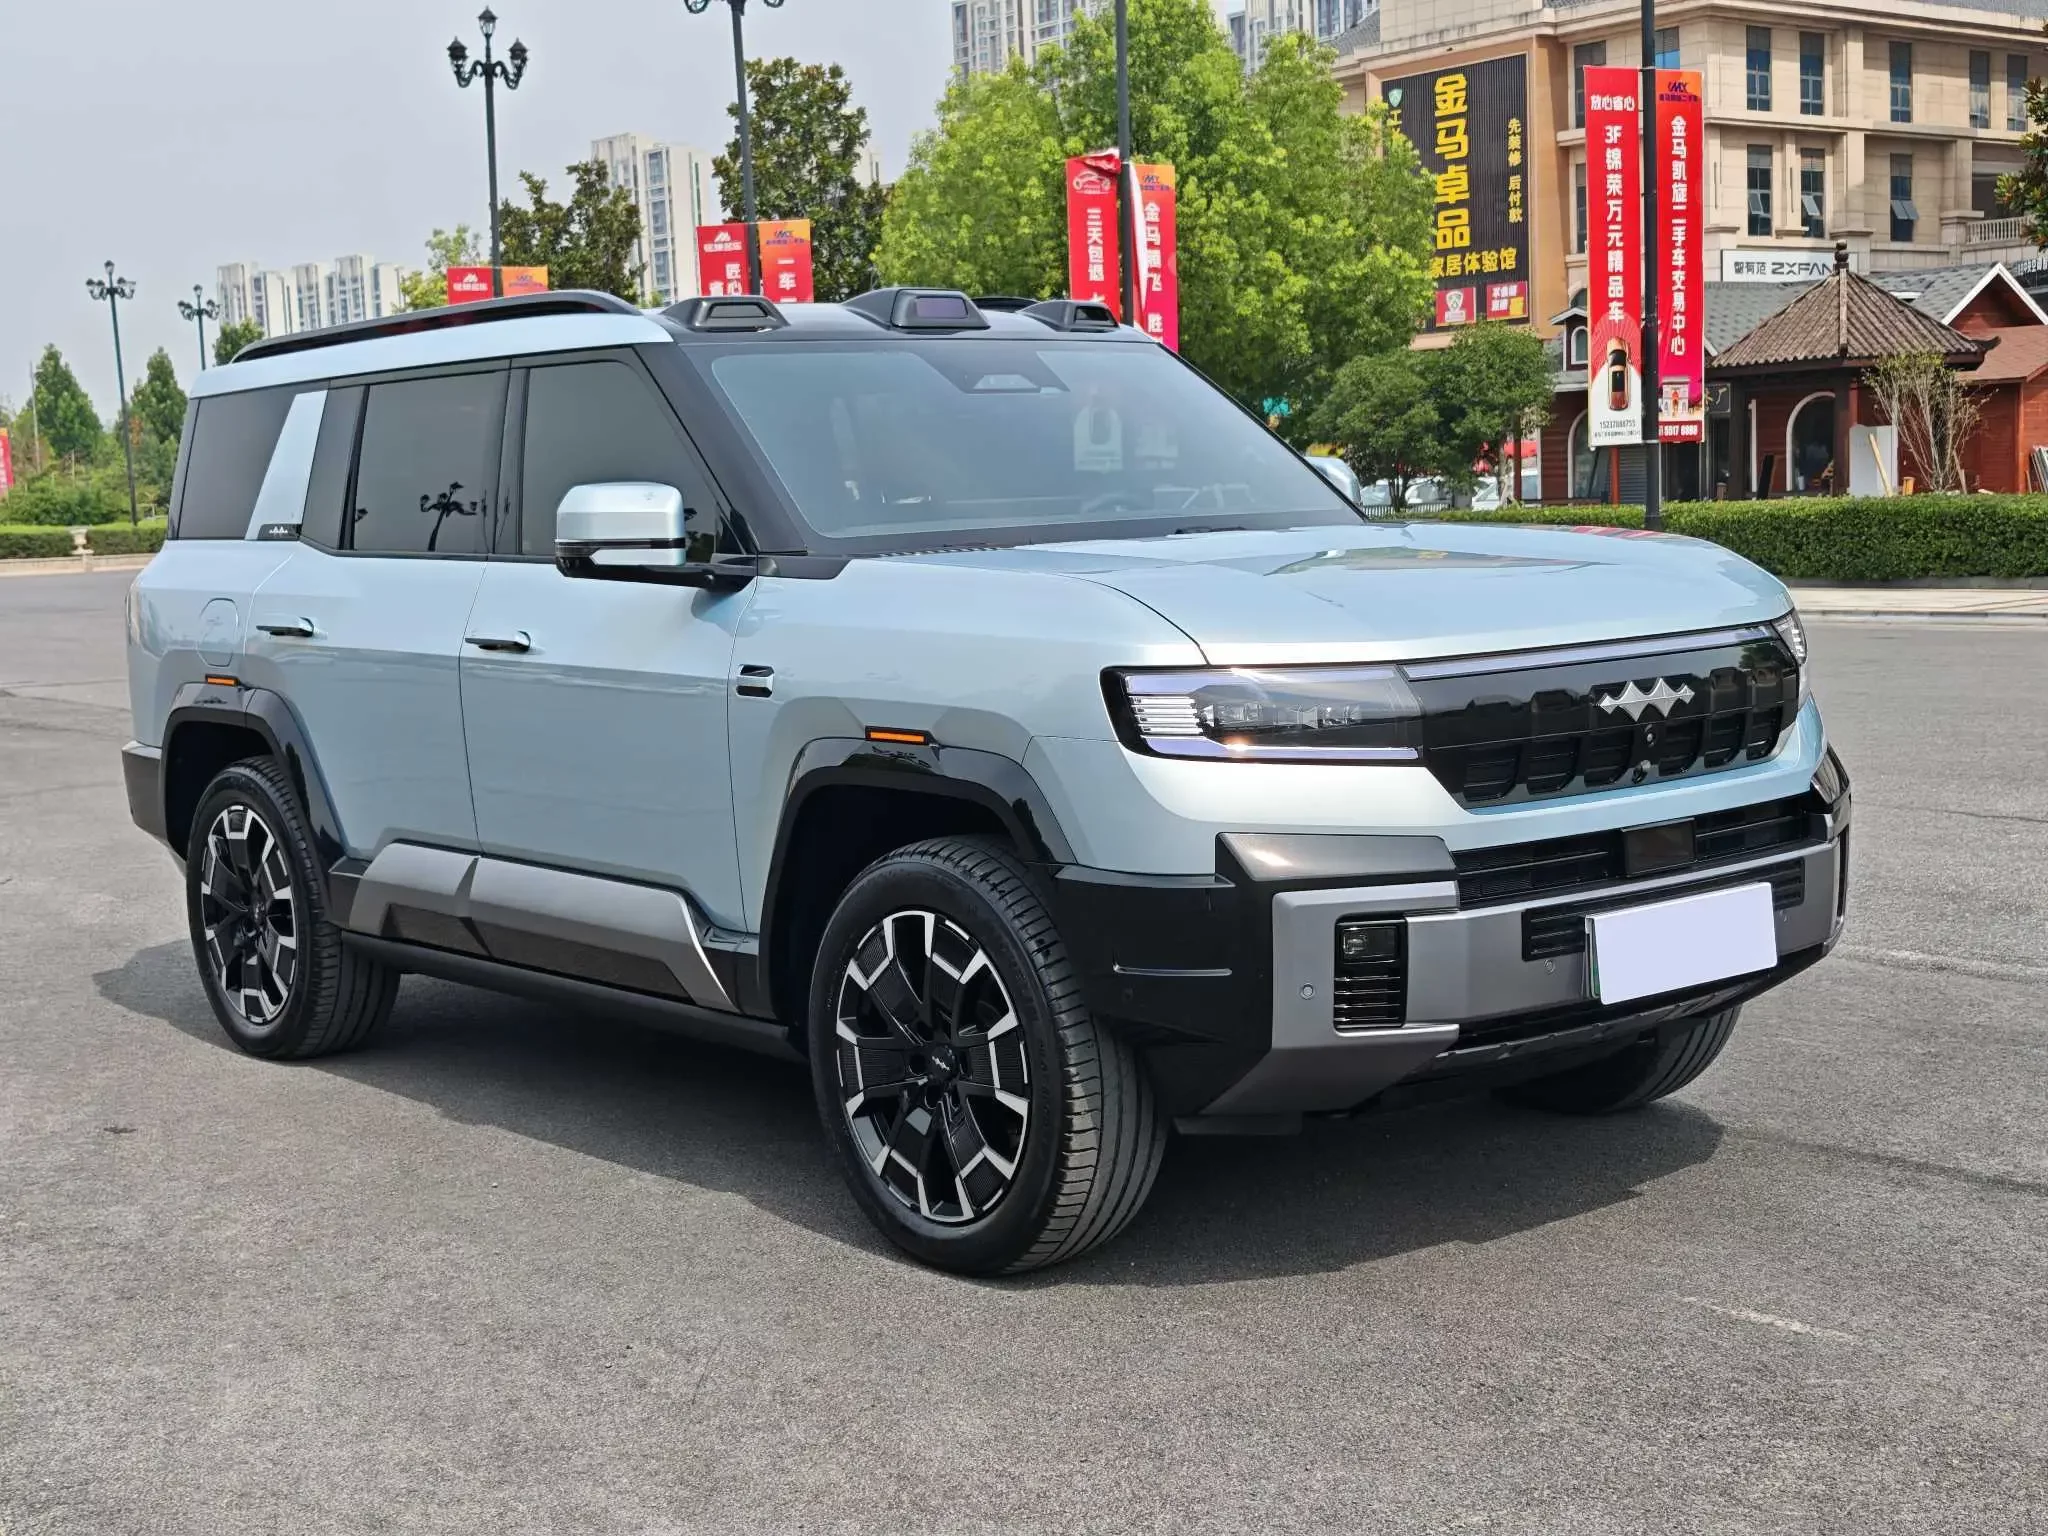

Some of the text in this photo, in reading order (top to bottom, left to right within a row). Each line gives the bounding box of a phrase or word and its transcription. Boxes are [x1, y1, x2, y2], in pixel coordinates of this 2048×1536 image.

[1590, 94, 1635, 112] 放心省心
[1434, 73, 1471, 250] 金马卓品
[1508, 174, 1523, 223] 后付款
[1670, 115, 1688, 356] 金马凯旋二手车交易中心
[1431, 247, 1517, 278] 家居体验馆
